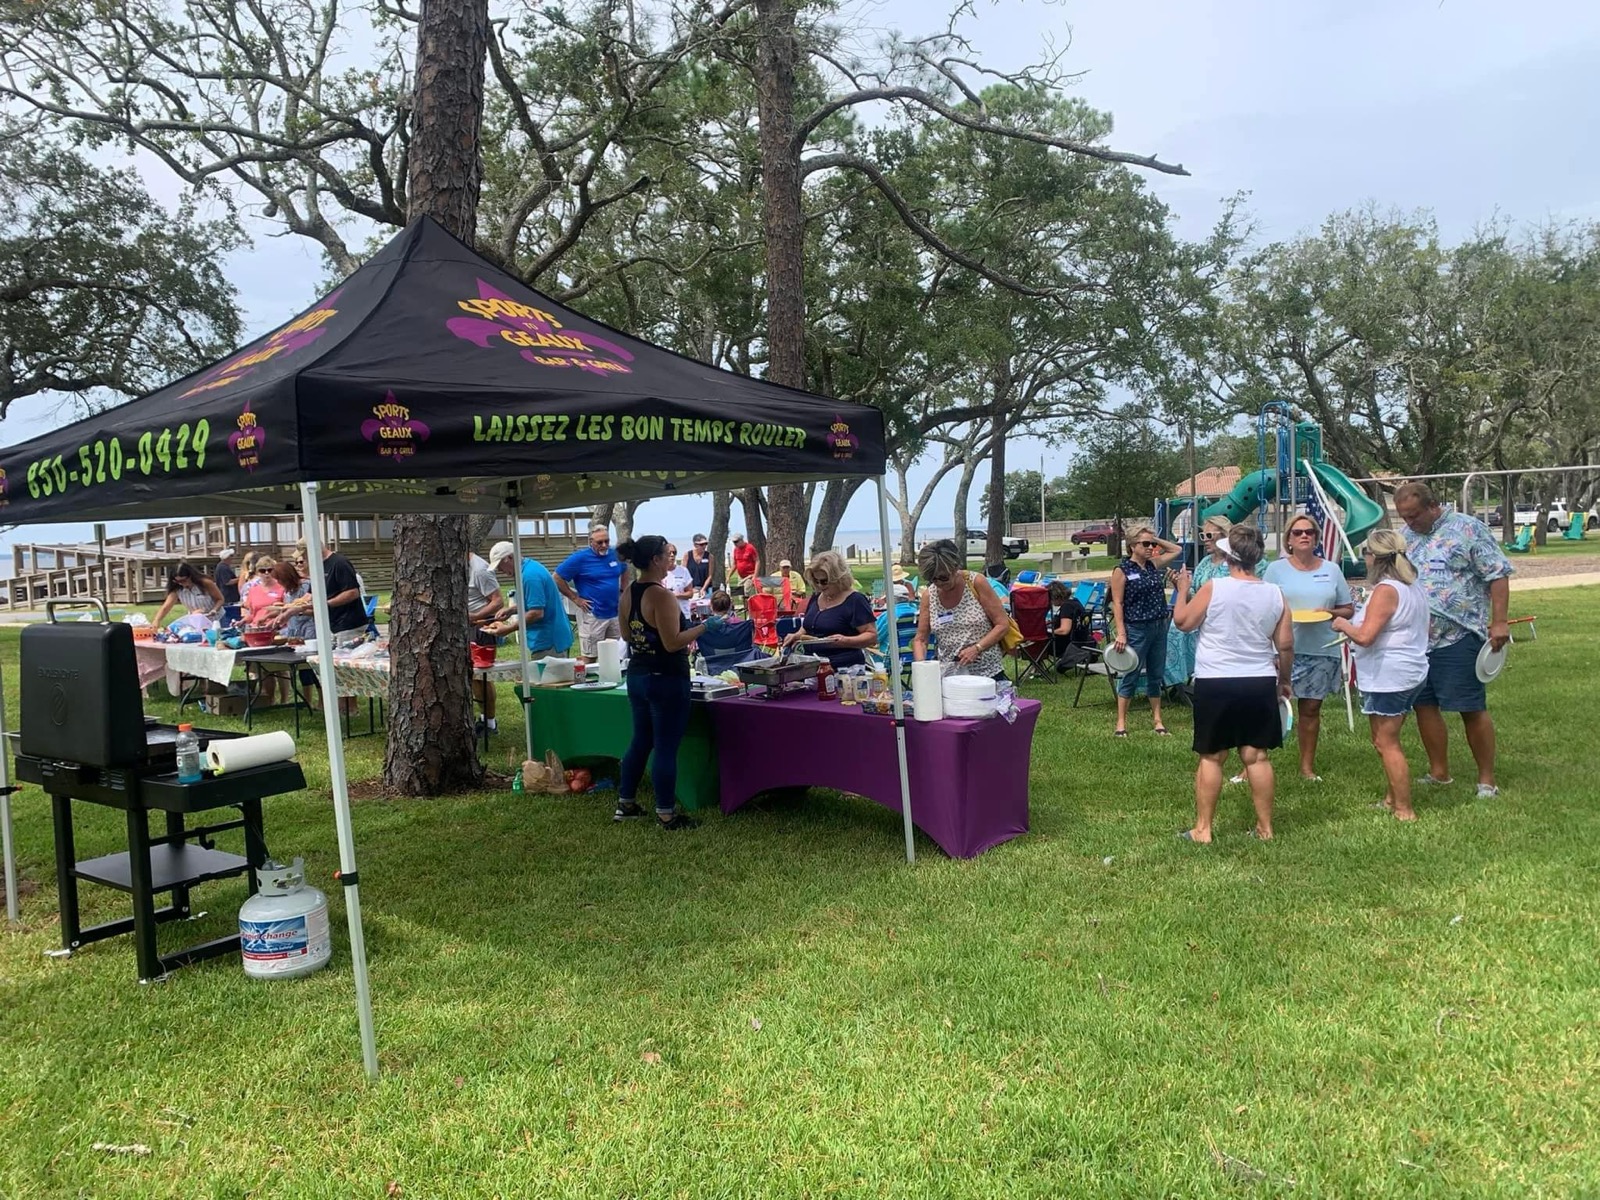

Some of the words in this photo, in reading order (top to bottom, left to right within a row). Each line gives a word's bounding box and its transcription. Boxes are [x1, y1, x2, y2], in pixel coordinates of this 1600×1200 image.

[457, 298, 563, 329] SPORTS
[500, 329, 594, 352] GEAUX
[533, 356, 570, 366] BAR
[372, 403, 410, 421] SPORTS
[380, 427, 412, 439] GEAUX
[473, 414, 570, 442] LAISSEZ
[575, 414, 615, 441] LES
[621, 415, 664, 442] BON
[670, 417, 736, 444] TEMPS
[739, 422, 807, 449] ROULER
[380, 447, 392, 455] BAR
